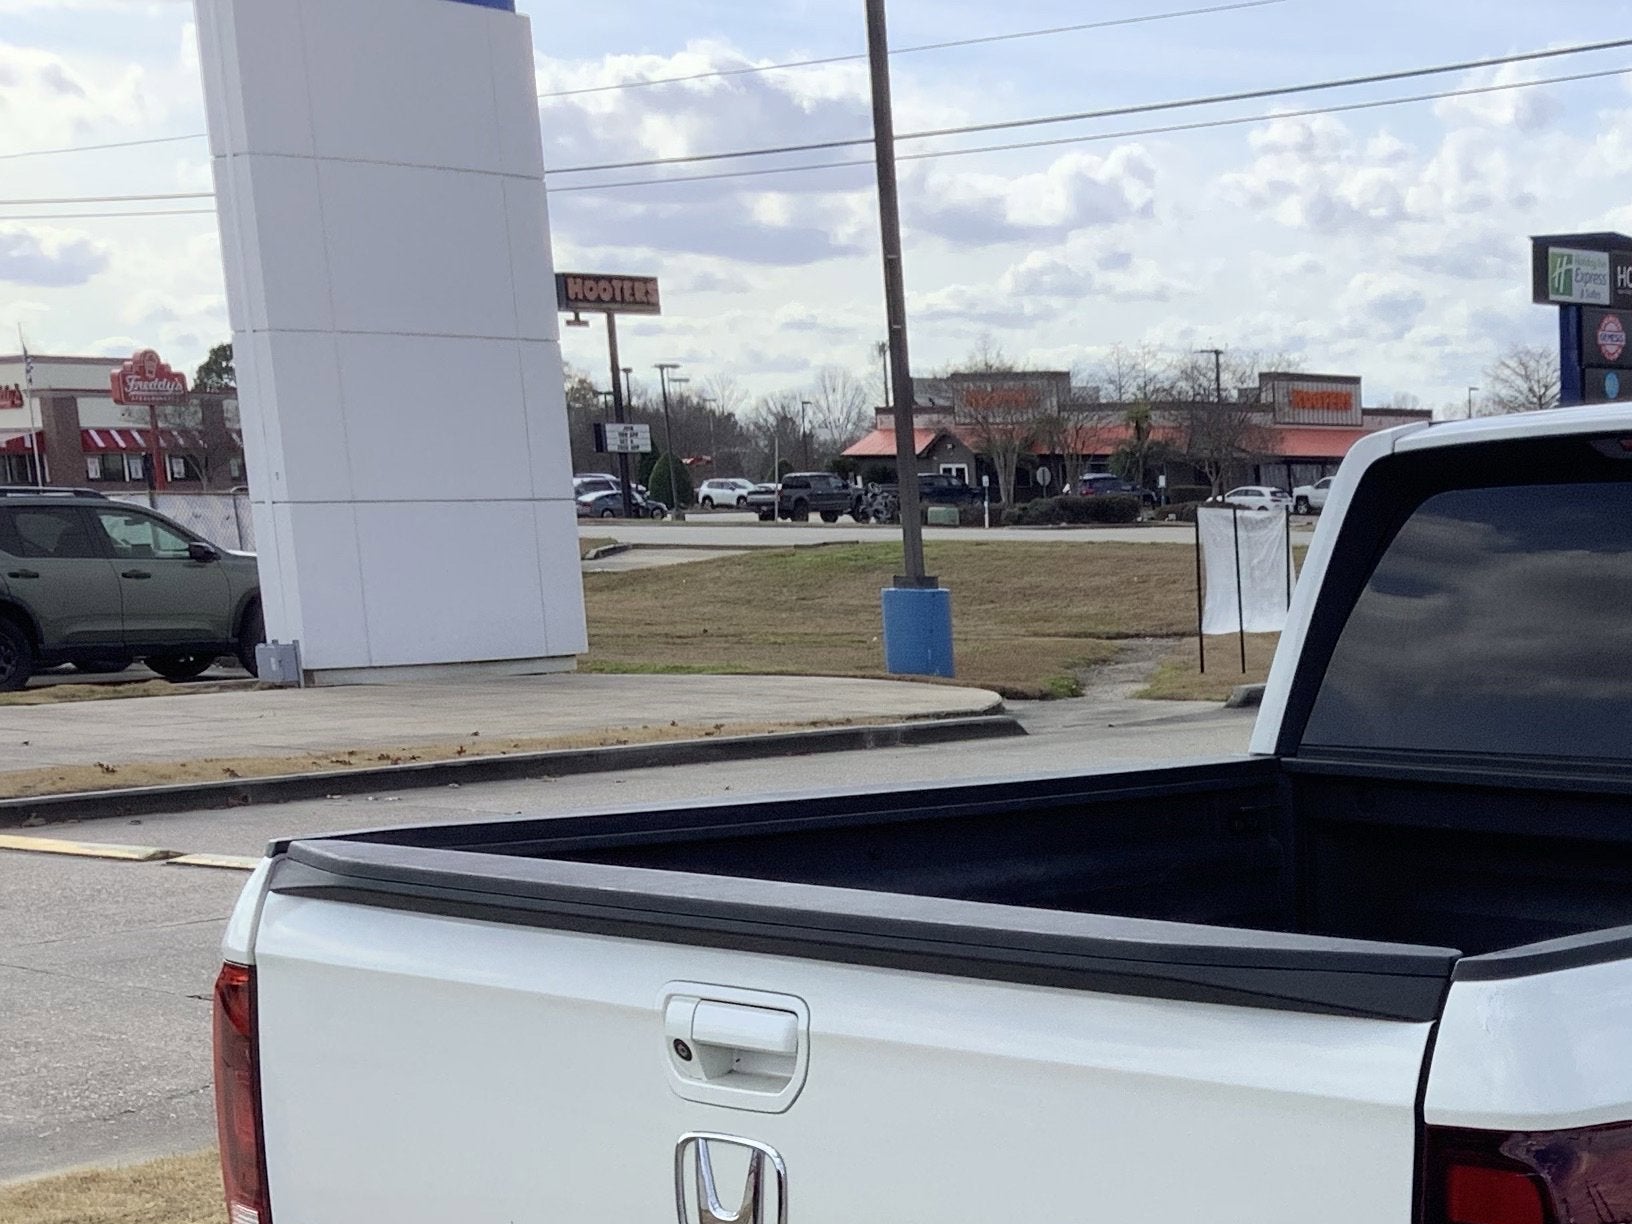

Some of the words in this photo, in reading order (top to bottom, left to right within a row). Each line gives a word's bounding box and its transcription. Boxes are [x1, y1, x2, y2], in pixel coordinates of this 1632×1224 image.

[1574, 267, 1607, 286] Express
[567, 277, 659, 305] HOOTERS
[125, 374, 184, 395] Freddy's
